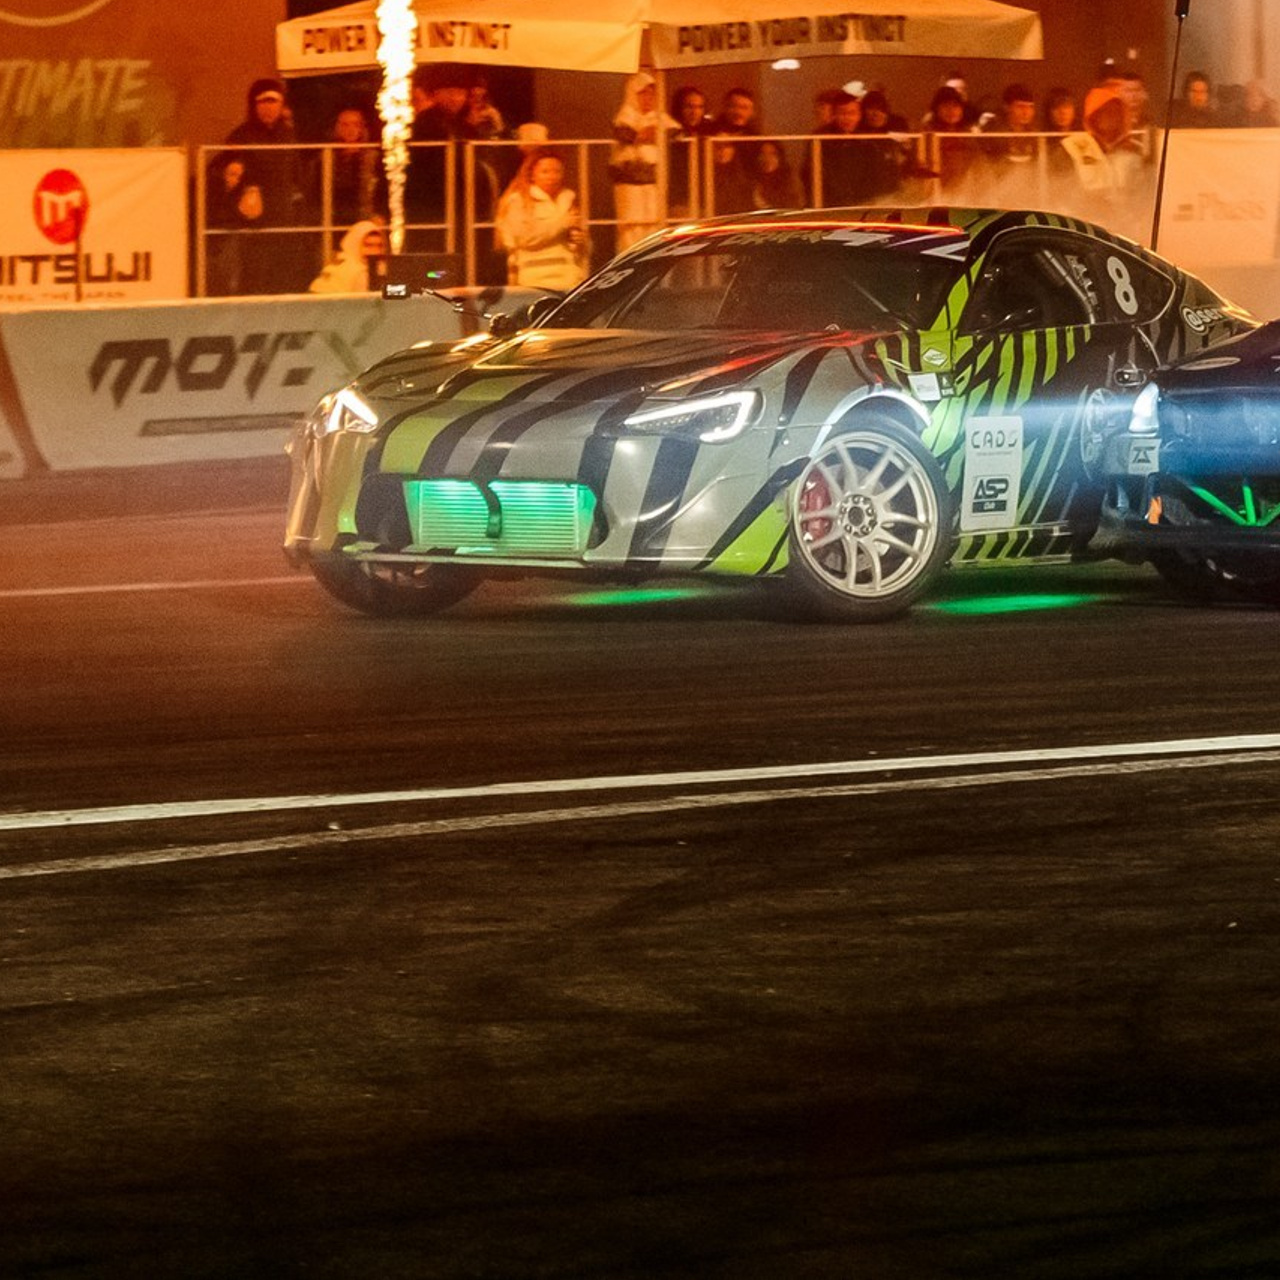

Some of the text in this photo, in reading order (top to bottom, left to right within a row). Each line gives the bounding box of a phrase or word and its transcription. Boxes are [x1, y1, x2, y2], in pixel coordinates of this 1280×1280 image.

[303, 24, 366, 55] POWER
[678, 21, 752, 54] POWER
[0, 251, 151, 286] ITSUJI
[1106, 255, 1139, 316] 8
